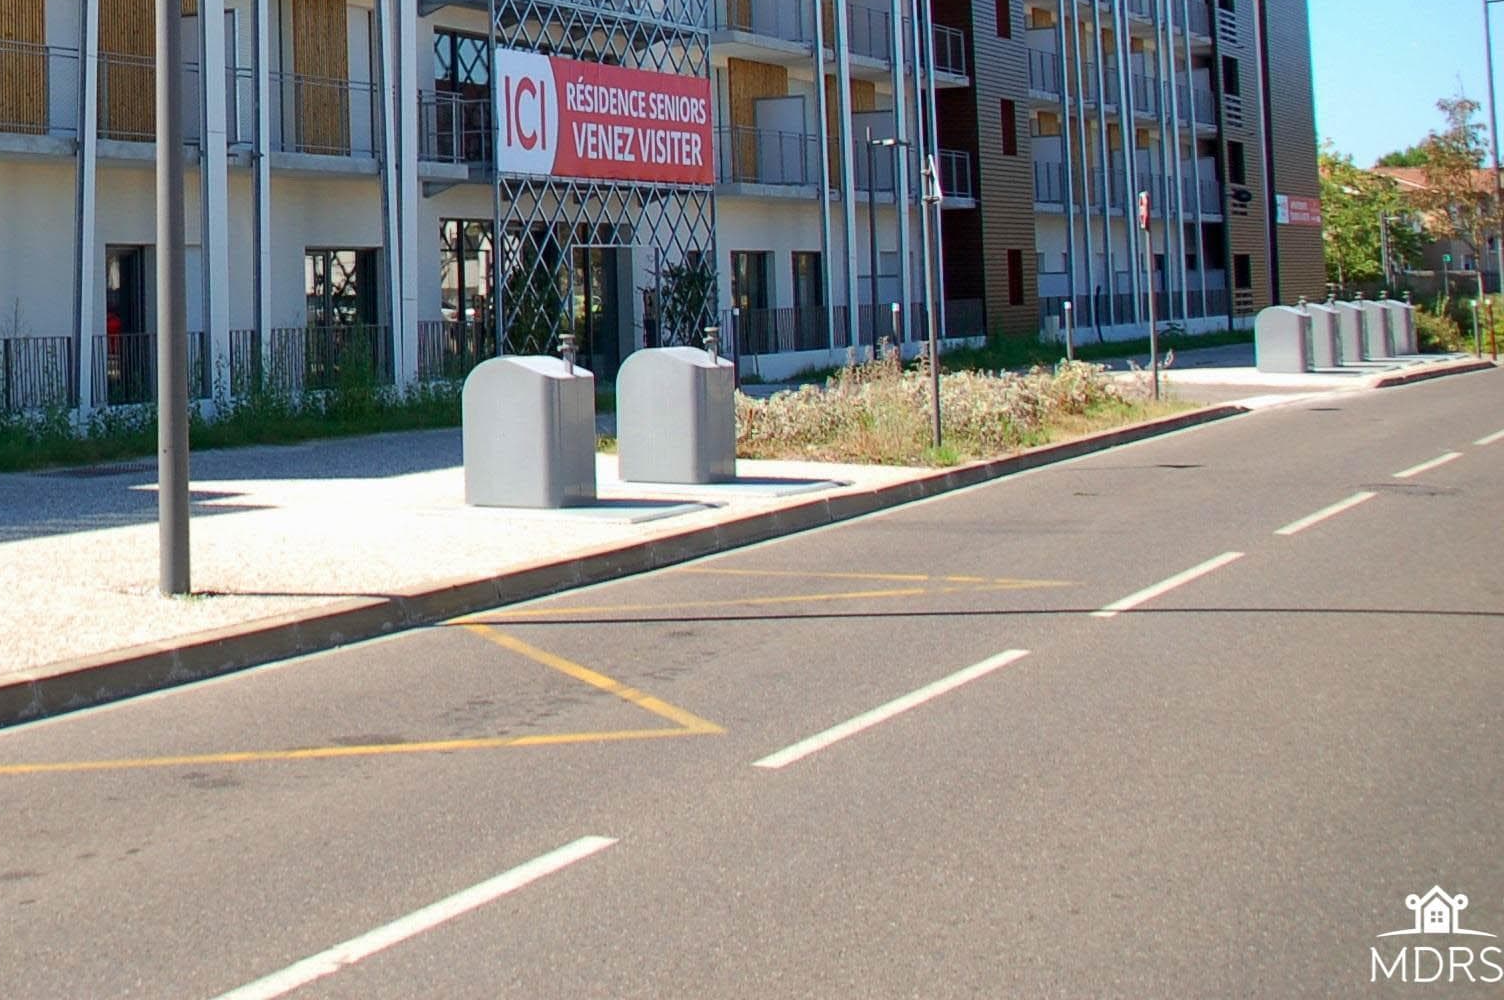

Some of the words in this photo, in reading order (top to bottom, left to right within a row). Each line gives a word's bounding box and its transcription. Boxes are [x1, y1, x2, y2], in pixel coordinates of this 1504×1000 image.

[505, 75, 546, 150] ICI
[566, 76, 647, 118] RÉSIDENCE
[648, 92, 706, 125] SENIORS
[572, 121, 635, 162] VENEZ
[638, 127, 703, 166] VISITER
